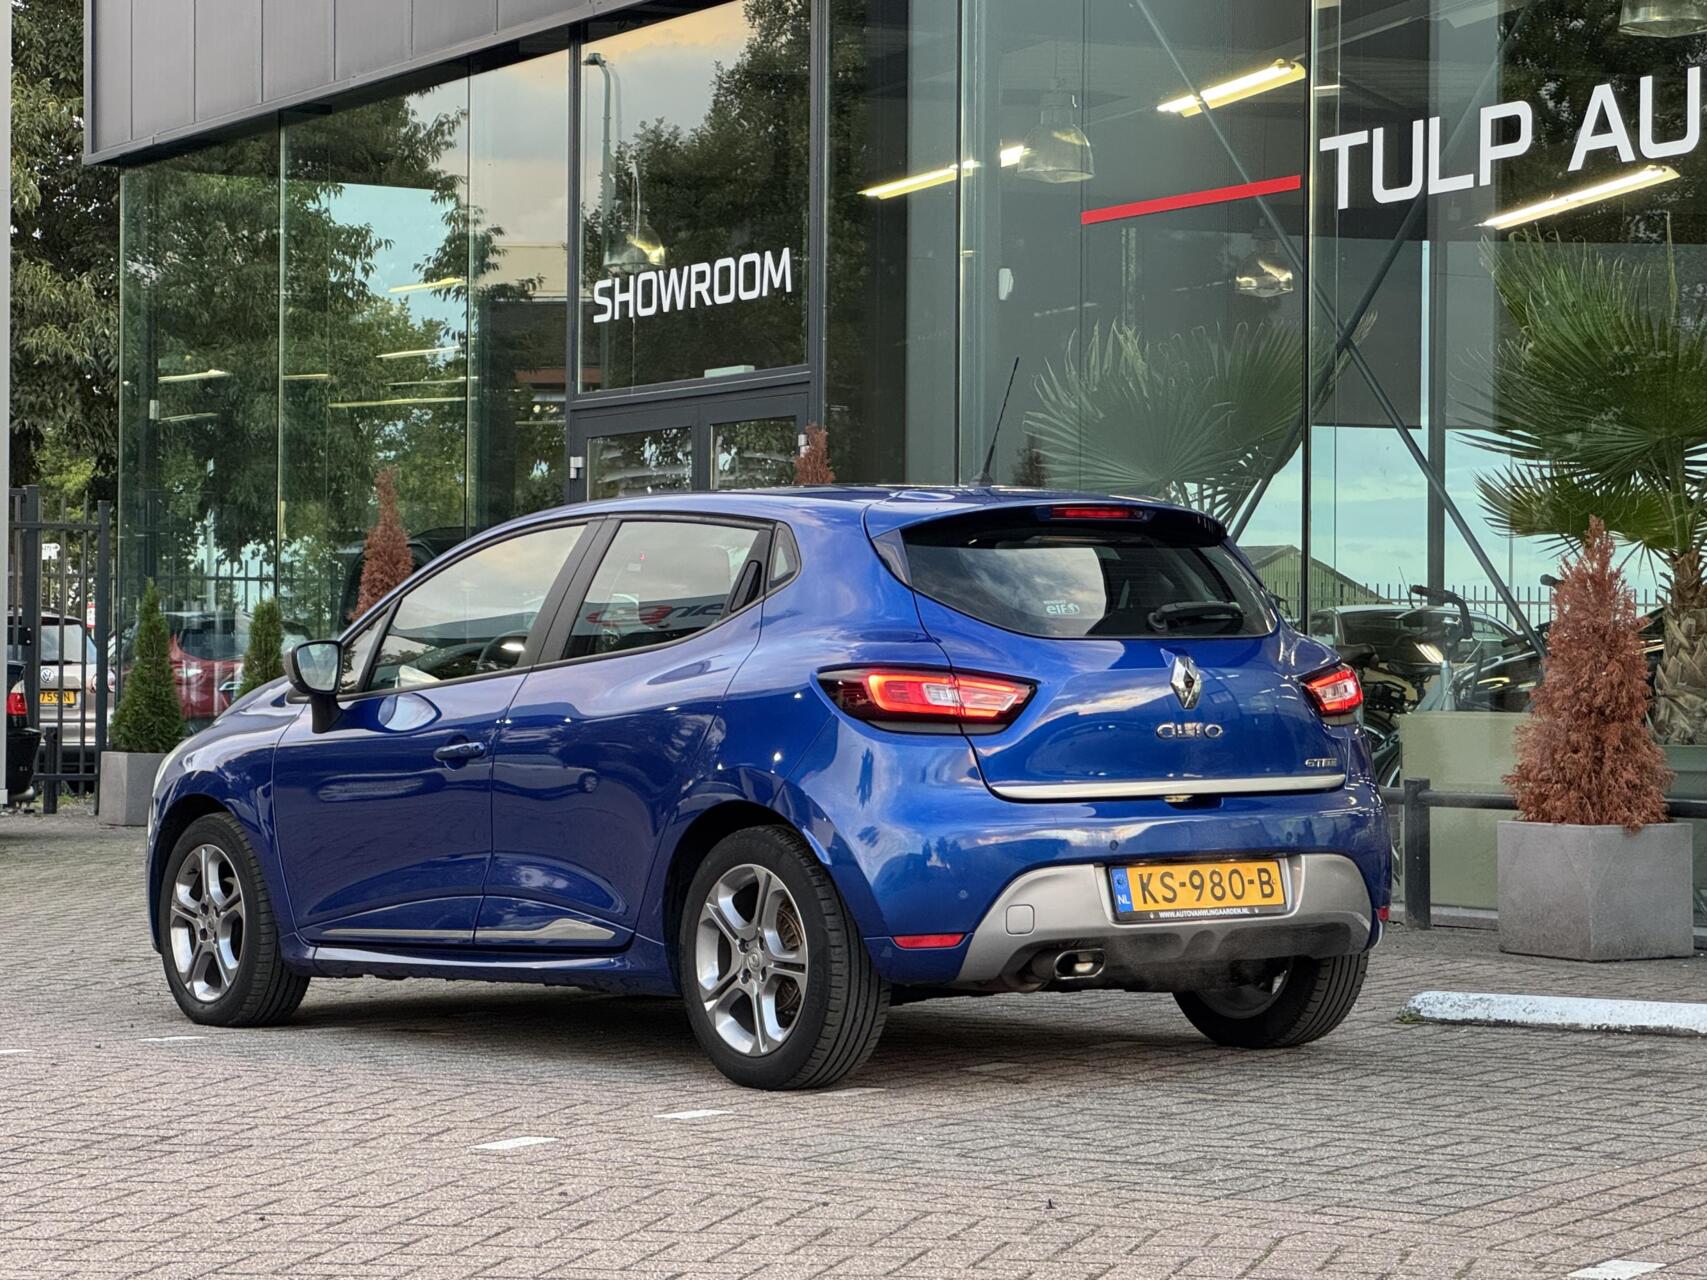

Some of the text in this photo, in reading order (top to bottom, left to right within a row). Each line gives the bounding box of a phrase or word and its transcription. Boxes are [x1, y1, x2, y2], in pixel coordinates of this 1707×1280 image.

[1319, 66, 1701, 210] TULP AU
[593, 247, 793, 324] SHOWROOM
[1117, 894, 1131, 906] NL
[1138, 867, 1275, 905] KS-980-B
